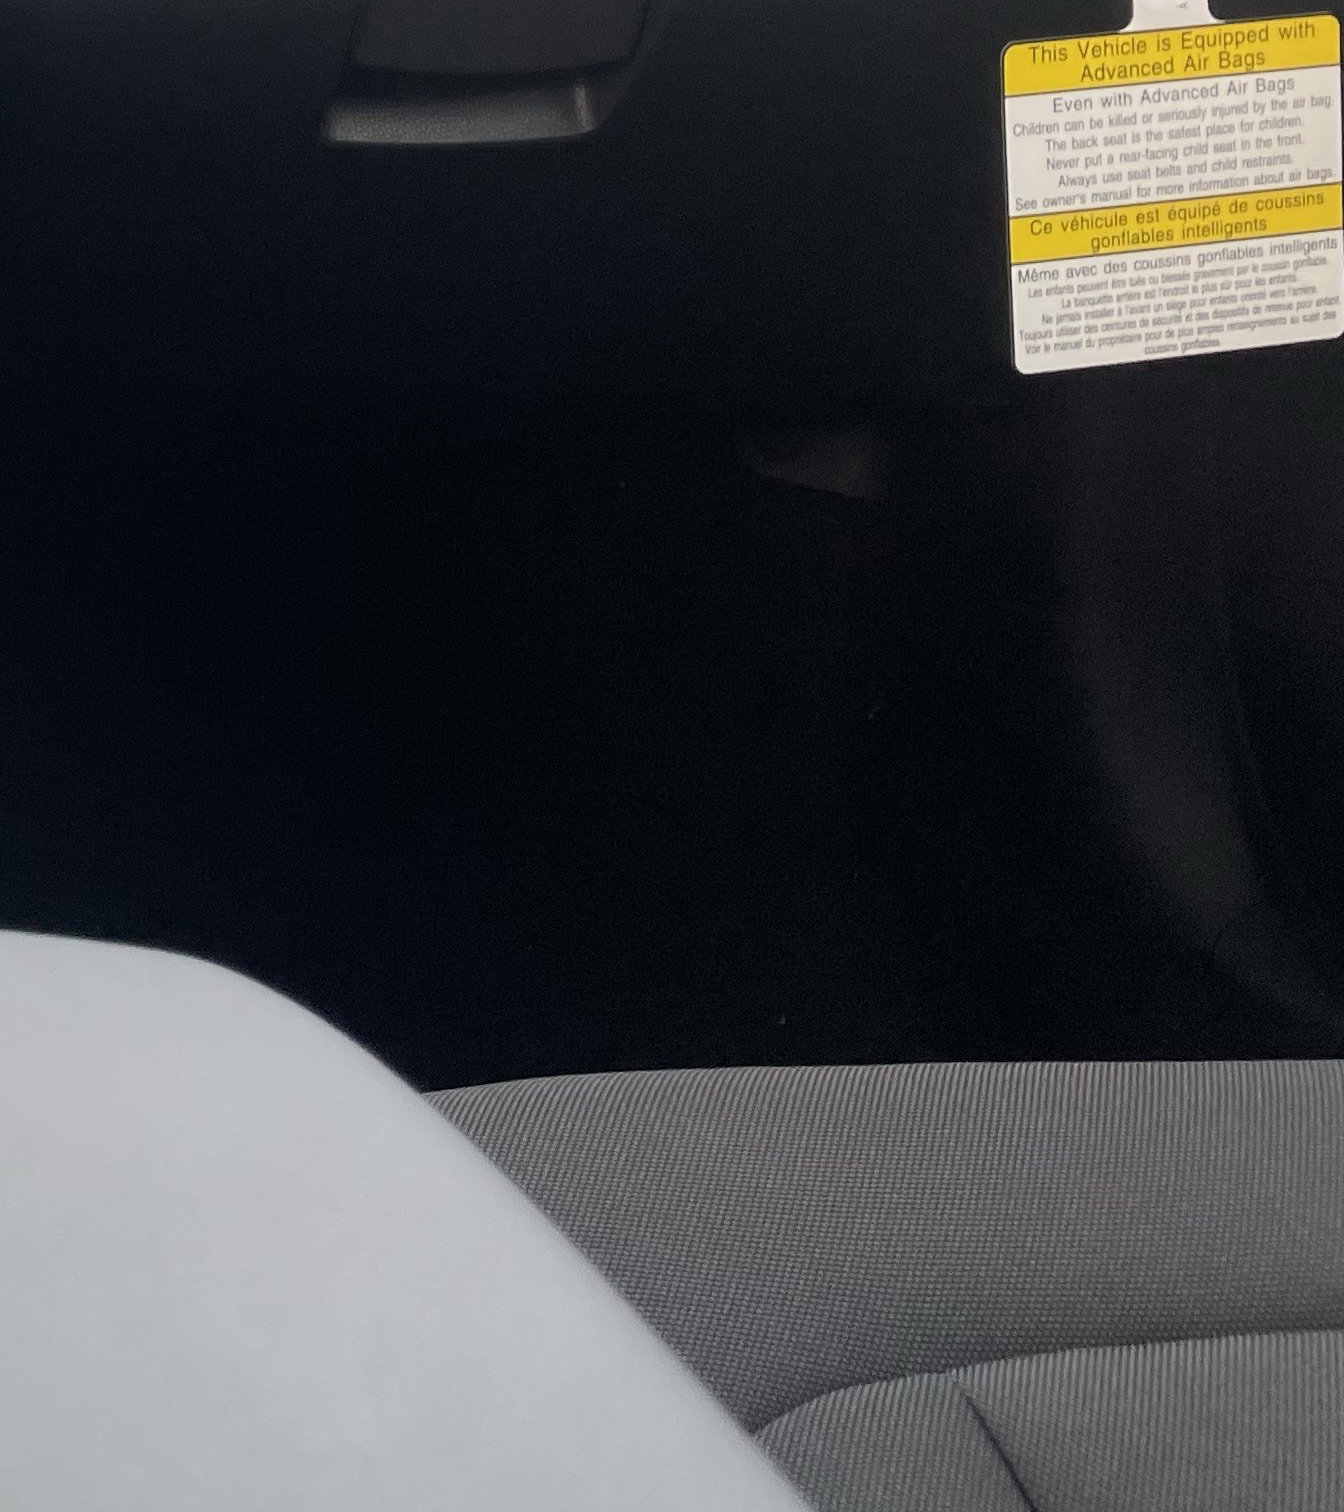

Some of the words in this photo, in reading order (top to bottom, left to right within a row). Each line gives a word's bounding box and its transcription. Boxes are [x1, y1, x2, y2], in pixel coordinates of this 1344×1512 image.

[1028, 45, 1069, 65] This
[1077, 36, 1148, 59] Vehicle
[1156, 33, 1172, 52] is
[1181, 23, 1270, 52] Equipped
[1278, 20, 1316, 40] with
[1080, 55, 1174, 83] Advanced
[1183, 53, 1210, 73] Air
[1218, 50, 1266, 72] Bags
[1053, 97, 1093, 113] Even
[1100, 91, 1133, 108] with
[1140, 80, 1219, 105] Advanced
[1226, 79, 1249, 96] Air
[1255, 76, 1295, 95] Bags
[1030, 219, 1053, 236] Ce
[1060, 211, 1128, 233] véhicule
[1135, 207, 1160, 224] est
[1167, 199, 1221, 222] équipé
[1228, 198, 1248, 214] de
[1255, 191, 1325, 211] coussins
[1181, 217, 1268, 239] intelligents
[1017, 268, 1060, 284] Même
[1065, 263, 1098, 279] avec
[1103, 259, 1128, 274] des
[1133, 253, 1192, 271] coussins
[1269, 237, 1338, 254] intelligents
